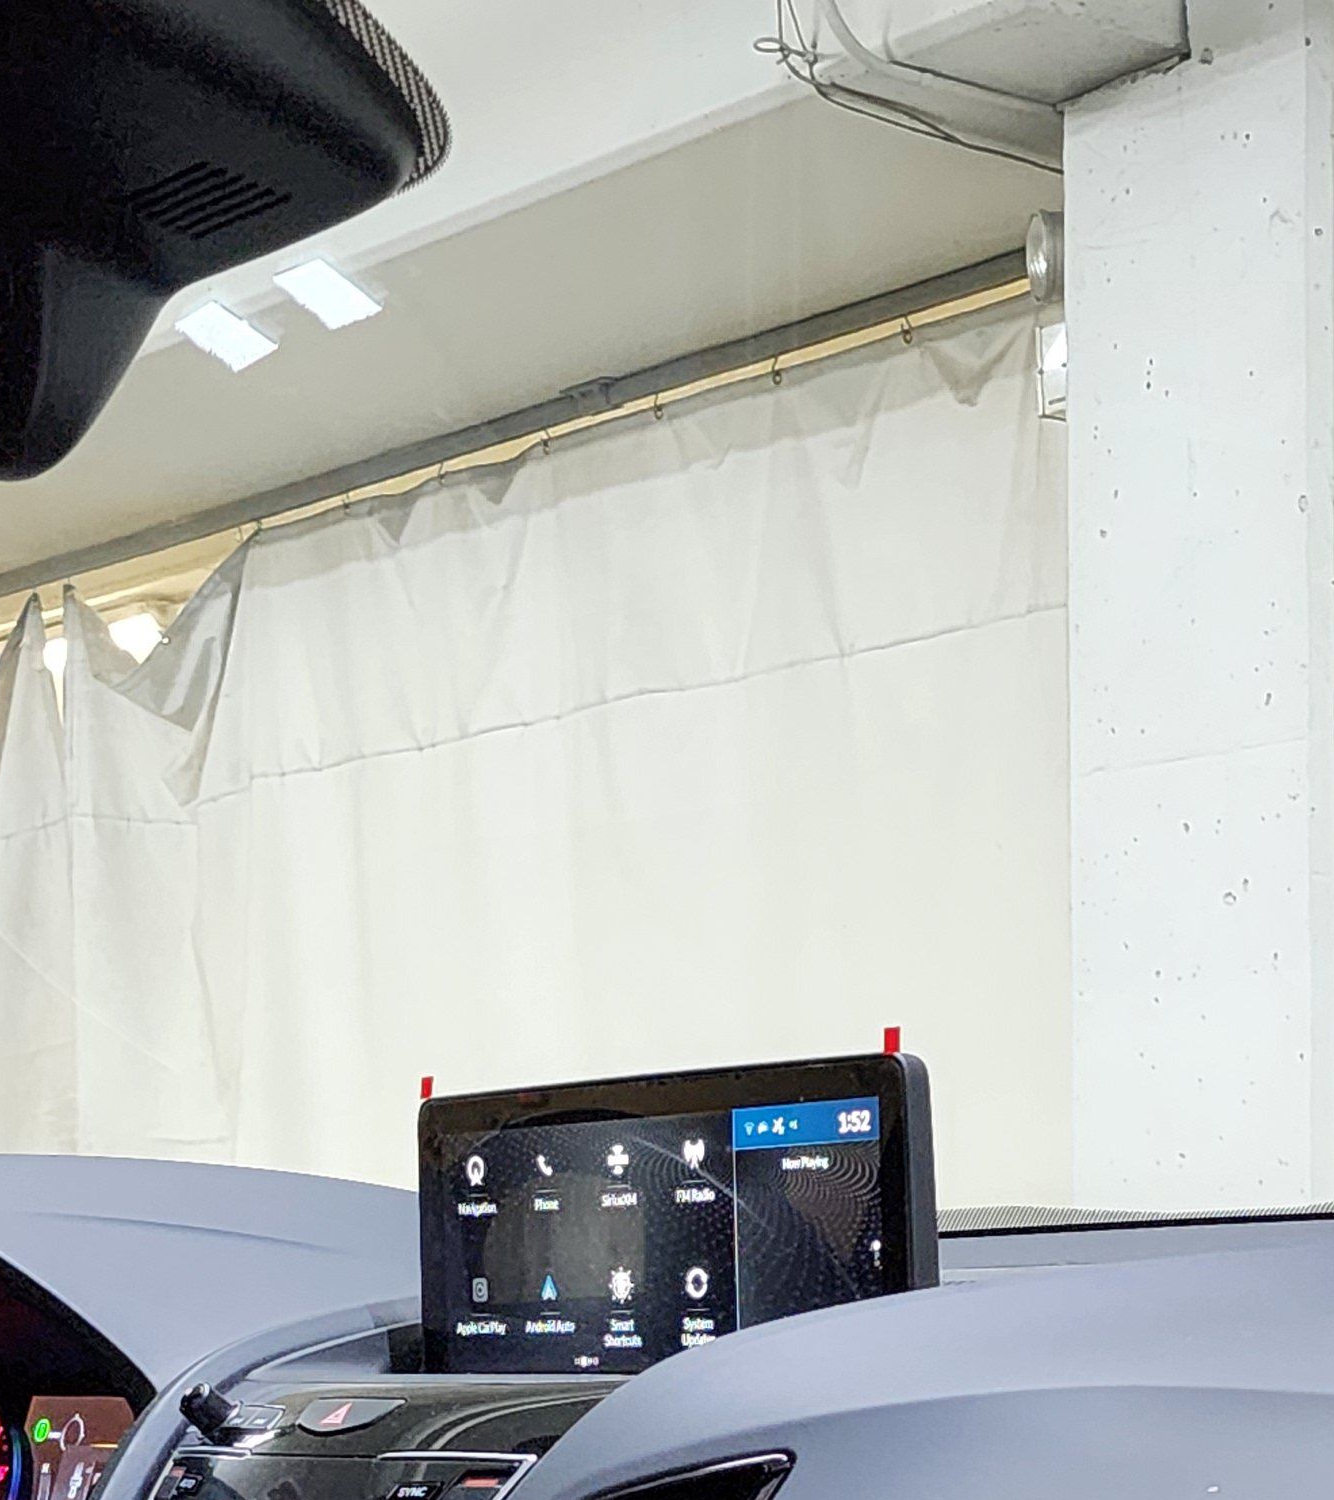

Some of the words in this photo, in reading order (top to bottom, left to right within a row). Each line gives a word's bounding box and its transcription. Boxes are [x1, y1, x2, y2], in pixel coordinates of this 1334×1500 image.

[837, 1109, 872, 1134] 1:52
[781, 1157, 800, 1170] Now
[692, 1188, 716, 1203] Radio
[458, 1202, 498, 1218] Navigation
[534, 1198, 560, 1212] Phone
[457, 1321, 478, 1336] Apple
[478, 1321, 508, 1335] CarPlay
[525, 1320, 556, 1334] Android
[556, 1320, 575, 1334] Auto
[610, 1318, 635, 1332] Smart
[682, 1317, 715, 1332] System
[603, 1333, 643, 1348] Shortcuts
[396, 1485, 428, 1498] SYNC
